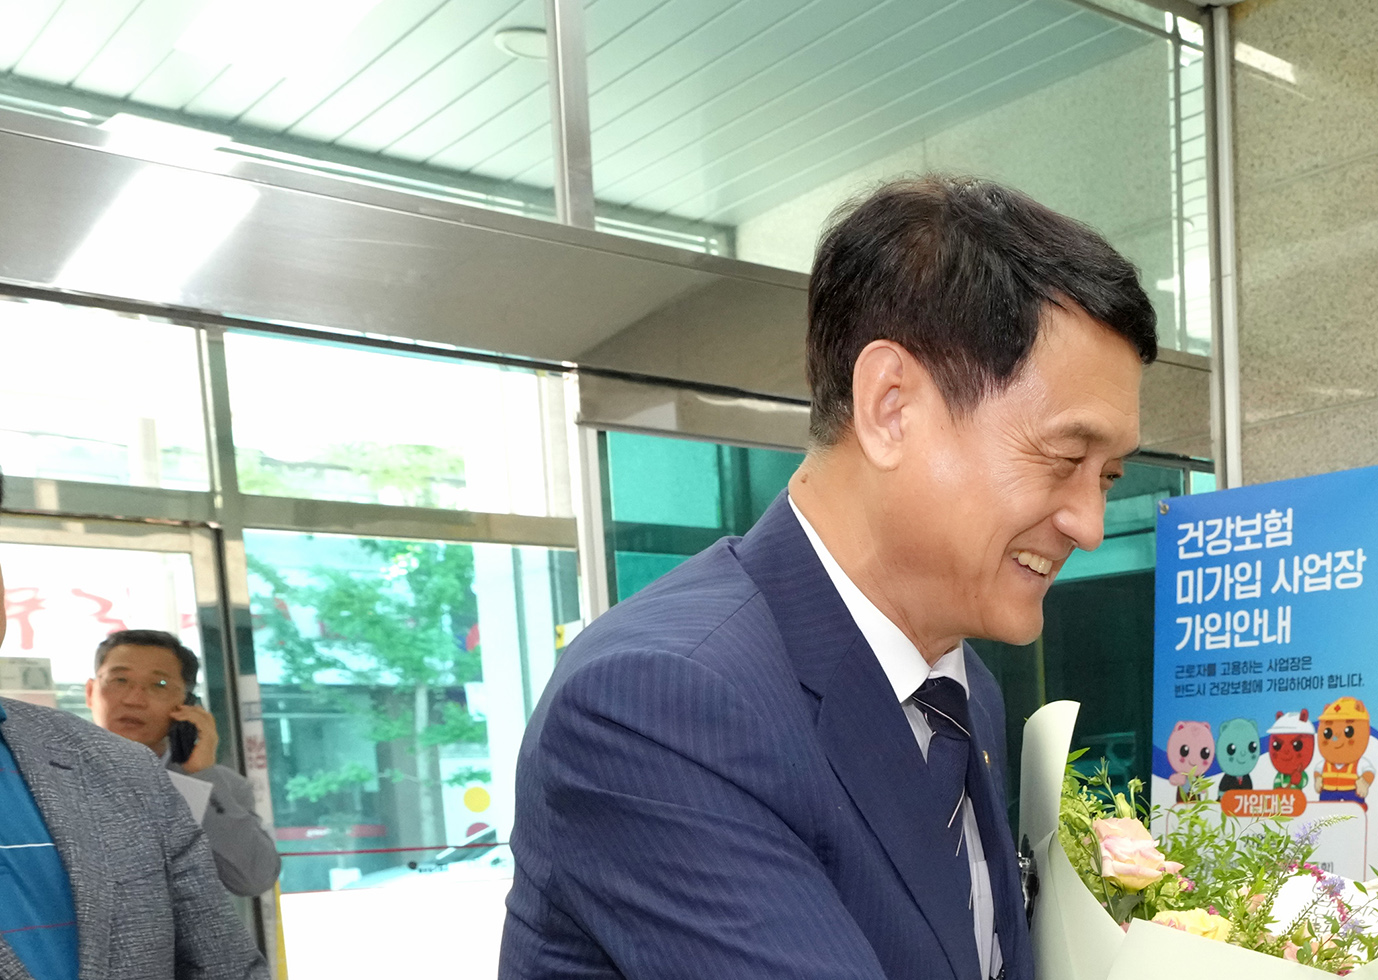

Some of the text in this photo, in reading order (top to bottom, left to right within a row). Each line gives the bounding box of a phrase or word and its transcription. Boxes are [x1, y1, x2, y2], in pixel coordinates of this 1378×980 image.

[1177, 508, 1294, 559] 건강보험
[1176, 548, 1366, 605] 미가입 사업장
[1175, 606, 1292, 652] 가입안내
[1174, 672, 1365, 698] 반드시 건강보험에 가입하여야 합니다.
[1175, 656, 1312, 680] 근로자를 고용하는 사업장은
[1234, 794, 1295, 815] 가입대상
